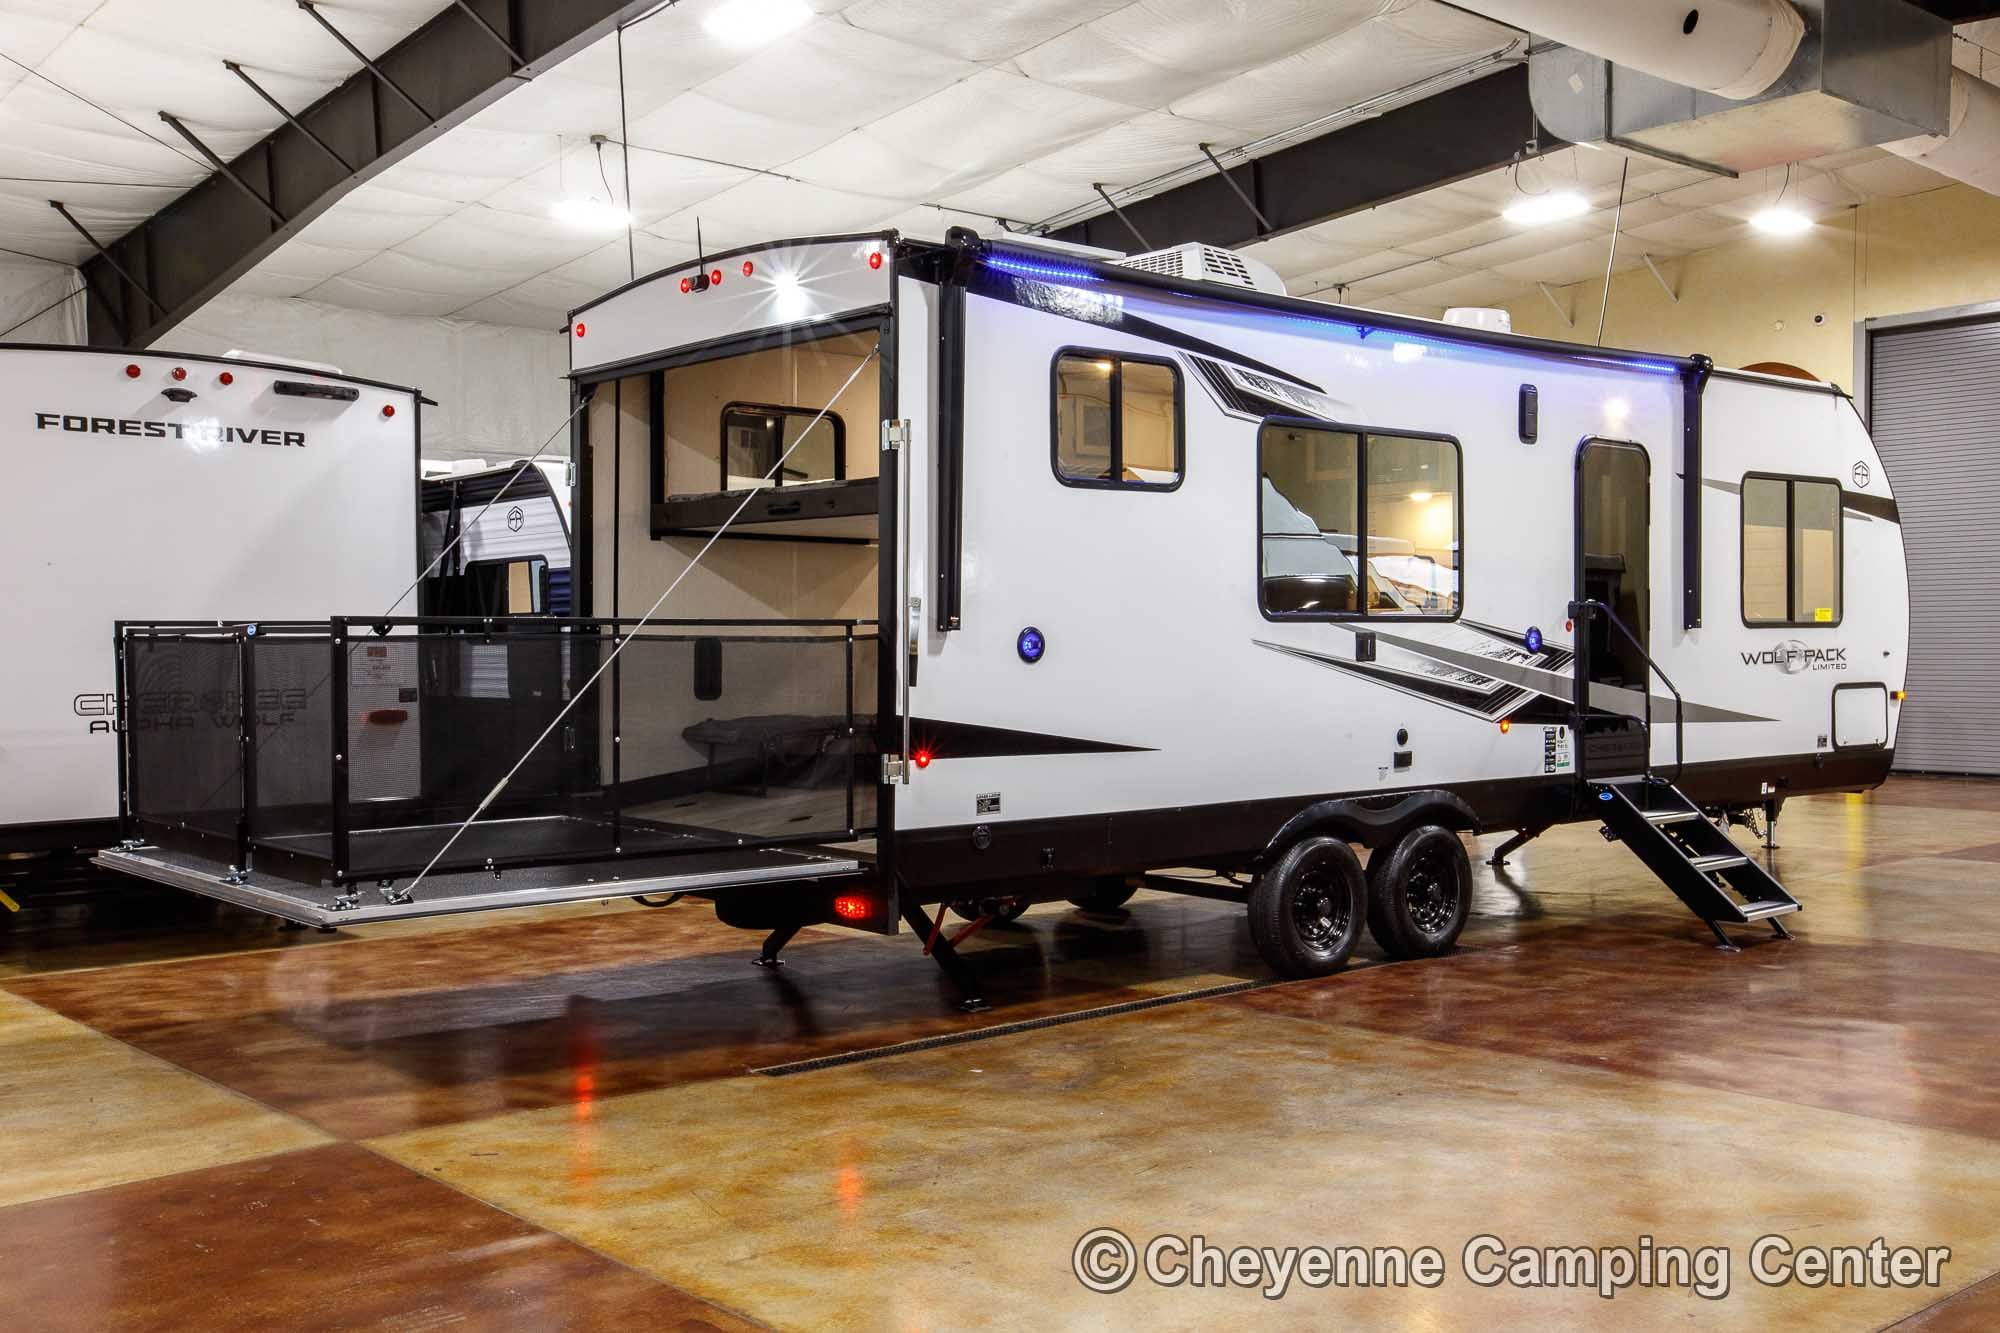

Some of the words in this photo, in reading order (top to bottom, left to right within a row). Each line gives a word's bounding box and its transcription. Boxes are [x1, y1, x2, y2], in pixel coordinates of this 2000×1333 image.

[35, 412, 190, 439] FOREST
[1741, 651, 1798, 665] WOLF
[1804, 648, 1846, 662] PACK
[1812, 663, 1847, 671] LIMITED
[212, 712, 296, 730] WLF
